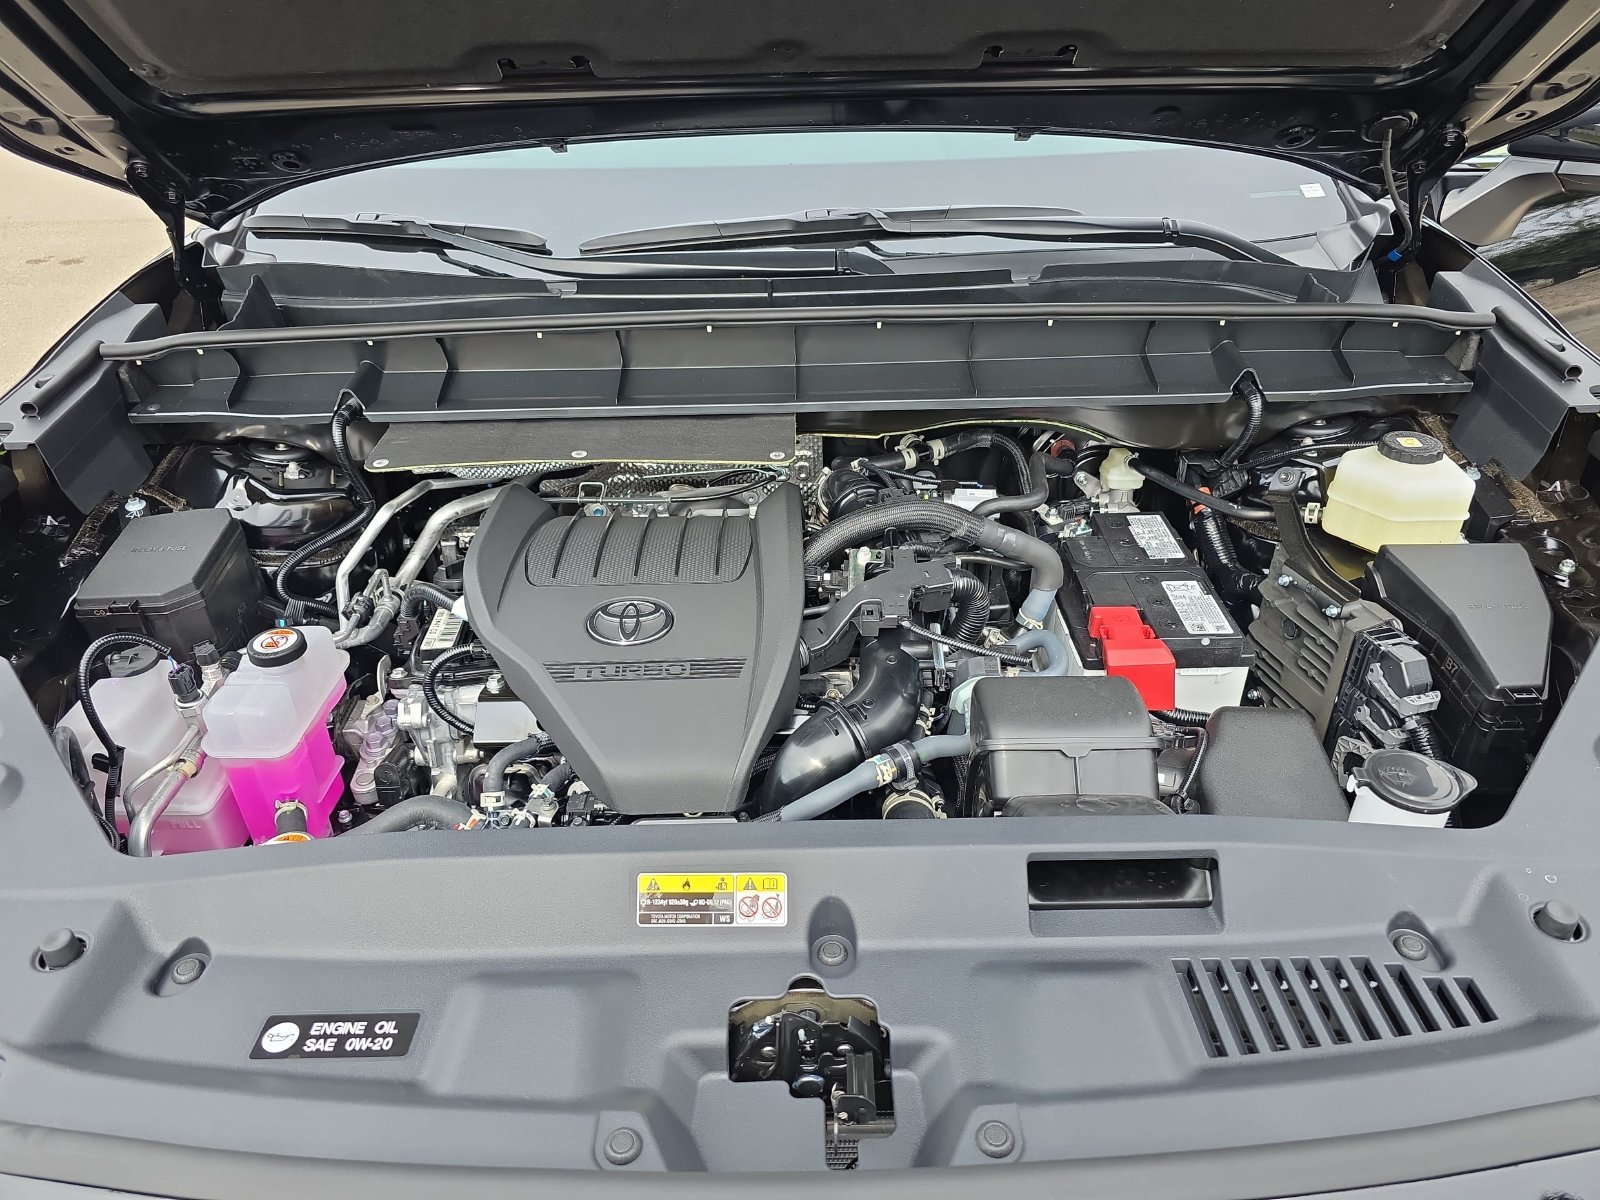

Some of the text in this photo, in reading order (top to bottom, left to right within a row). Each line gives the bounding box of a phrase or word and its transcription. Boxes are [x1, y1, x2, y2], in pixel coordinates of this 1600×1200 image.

[578, 663, 688, 678] TURBO
[719, 914, 731, 923] WS
[309, 1020, 399, 1035] ENGINE OIL
[302, 1036, 394, 1052] SAE 0W-20
